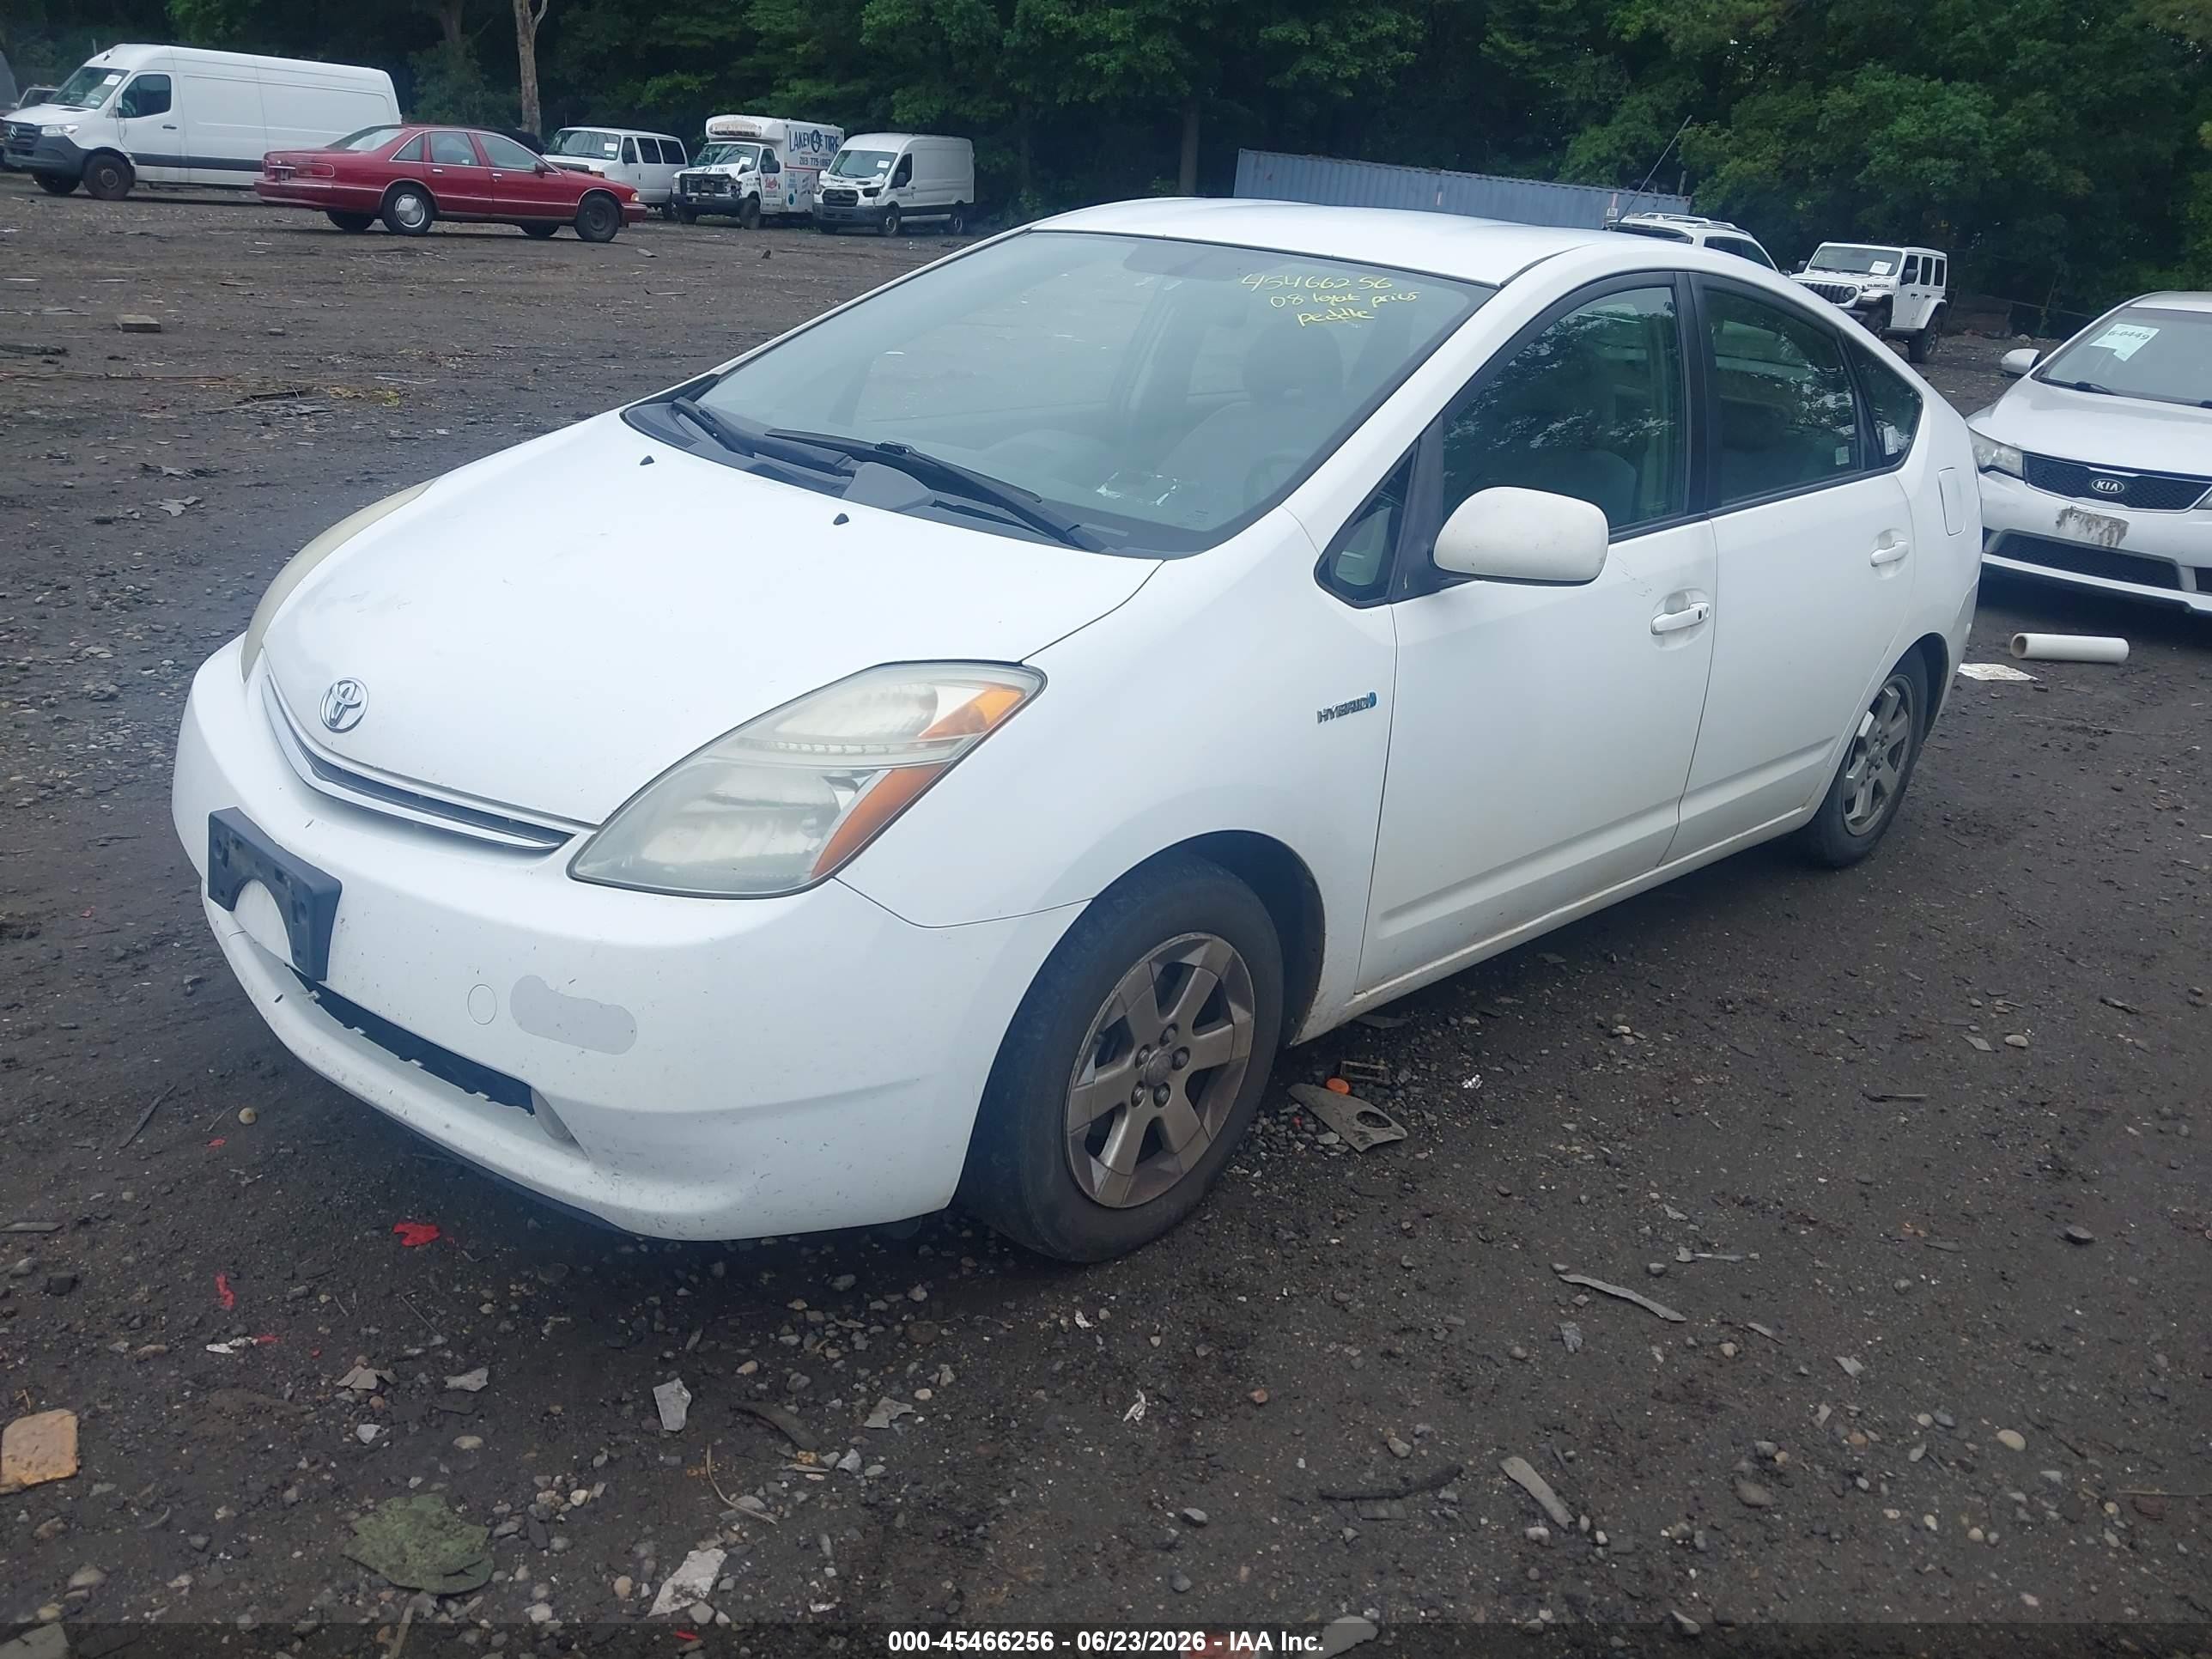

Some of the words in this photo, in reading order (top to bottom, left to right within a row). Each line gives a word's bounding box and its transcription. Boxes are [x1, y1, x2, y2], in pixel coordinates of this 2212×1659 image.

[1270, 293, 1305, 308] 08
[2096, 480, 2118, 492] KIA
[1317, 692, 1376, 724] HYBRID
